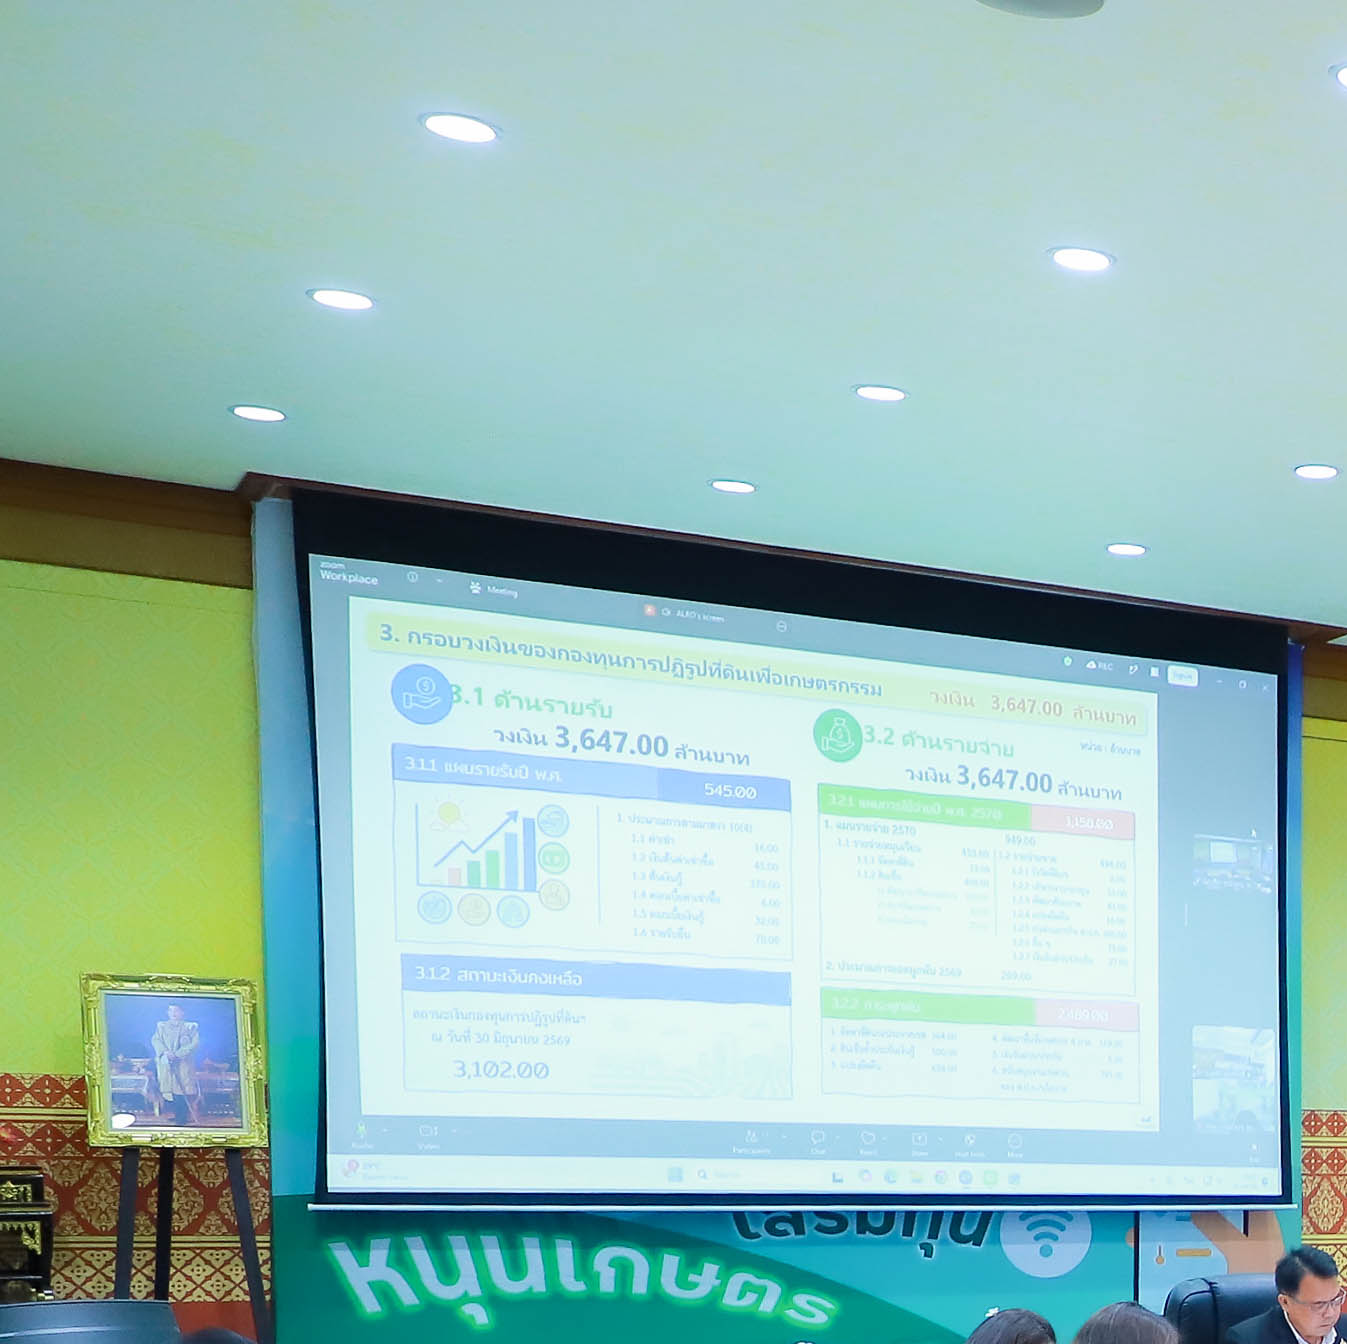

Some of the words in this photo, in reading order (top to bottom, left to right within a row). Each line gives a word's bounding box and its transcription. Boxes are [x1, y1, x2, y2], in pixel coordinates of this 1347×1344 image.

[320, 569, 379, 586] Workplace
[380, 623, 400, 642] 3.
[991, 693, 1063, 719] 3,647.00
[554, 724, 669, 759] 3,647.00
[862, 724, 895, 746] 3.2
[704, 781, 757, 801] 545.00
[956, 763, 1053, 793] 3,647.00
[453, 1059, 550, 1080] 3,102.00
[327, 1234, 836, 1326] หนุนเกษตร
